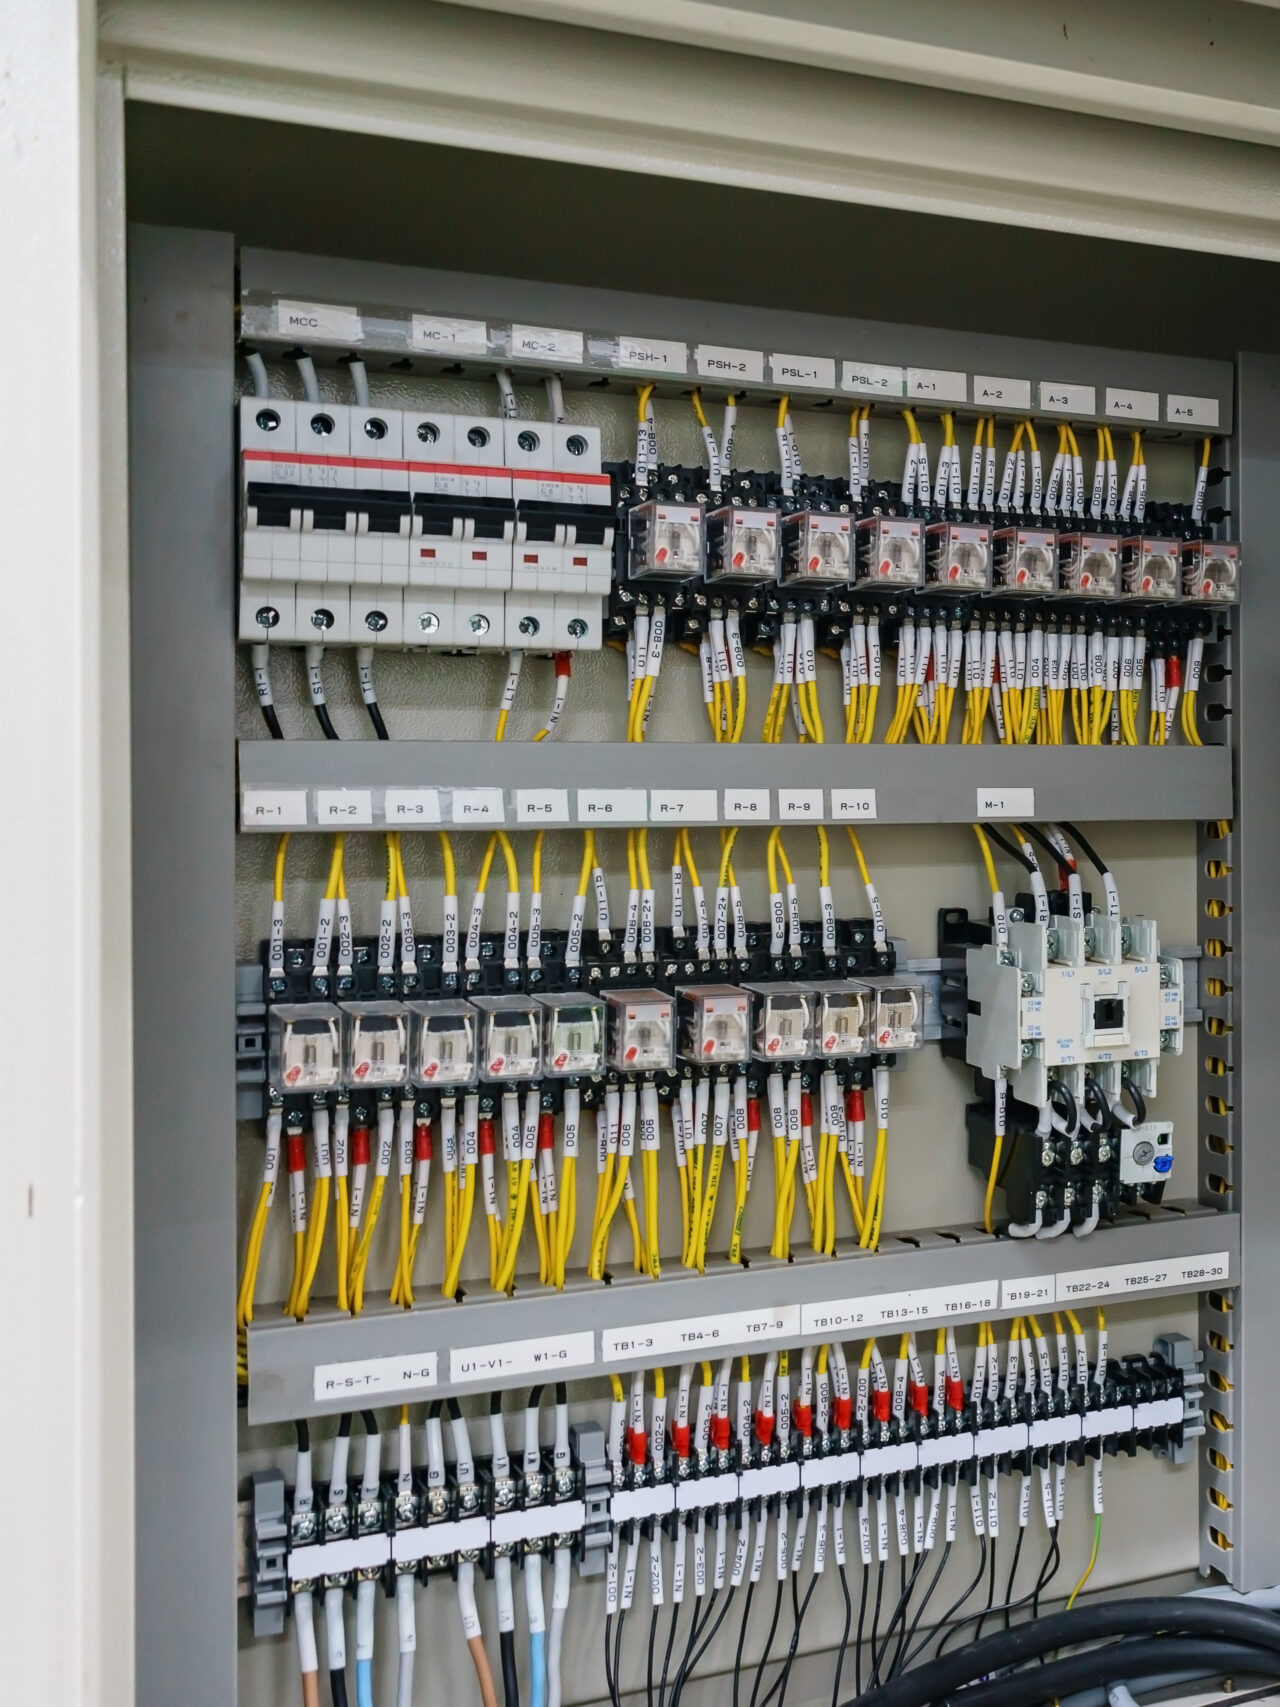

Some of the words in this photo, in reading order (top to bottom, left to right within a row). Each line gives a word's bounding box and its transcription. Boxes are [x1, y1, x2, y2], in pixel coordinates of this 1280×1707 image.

[289, 316, 318, 327] MCC
[423, 330, 456, 342] MC-1
[522, 340, 556, 351] MC-2
[630, 352, 667, 362] PSH-1
[708, 360, 746, 372] PSH-2
[782, 368, 817, 378] PSL-1
[852, 376, 888, 386] PSL-2
[917, 382, 936, 390] A-1
[982, 390, 1002, 398] A-2
[1049, 396, 1068, 404] A-3
[1114, 402, 1132, 410] A-4
[1175, 408, 1194, 416] A-5
[647, 418, 657, 455] 008-4
[638, 430, 648, 474] 011-13
[789, 432, 801, 467] 010-1
[908, 460, 917, 494] 011-7
[919, 457, 928, 492] 011-5
[938, 462, 950, 496] 011-3
[952, 462, 960, 494] 011-1
[652, 620, 662, 658] 008-3
[718, 650, 728, 672] 011
[256, 666, 269, 697] R1-1
[310, 665, 322, 695] S1-1
[361, 666, 372, 694] T1-1
[256, 806, 282, 816] R-1
[330, 806, 357, 815] R-2
[398, 804, 424, 814] R-3
[464, 804, 489, 814] R-4
[528, 804, 552, 812] R-5
[588, 804, 613, 813] R-6
[661, 804, 684, 812] R-7
[734, 802, 758, 812] R-8
[788, 802, 811, 812] R-9
[840, 802, 870, 811] R-10
[1039, 893, 1048, 922] R1-1
[1072, 892, 1082, 919] S1-1
[1109, 890, 1118, 916] T1-1
[403, 912, 414, 952] 003-3
[469, 908, 482, 948] 004-3
[508, 911, 518, 950] 004-2
[775, 902, 784, 939] 008-3
[997, 914, 1008, 934] 010
[272, 919, 282, 960] 001-3
[317, 918, 330, 958] 001-2
[340, 915, 350, 956] 002-3
[381, 919, 392, 958] 002-2
[446, 913, 456, 952] 003-2
[570, 914, 583, 953] 005-2
[714, 1114, 723, 1136] 007
[737, 1108, 745, 1130] 008
[774, 1106, 782, 1128] 008
[466, 1131, 476, 1154] 004
[512, 1125, 520, 1148] 004
[526, 1125, 536, 1149] 005
[566, 1124, 576, 1147] 005
[610, 1123, 618, 1144] 011
[622, 1124, 632, 1146] 006
[1066, 1281, 1110, 1294] TB22-24
[1125, 1274, 1167, 1286] TB25-27
[1182, 1267, 1222, 1280] TB28-30
[1007, 1288, 1048, 1301] B19-21
[814, 1314, 864, 1328] TB10-12
[880, 1306, 928, 1319] TB13-15
[945, 1299, 990, 1312] TB16-18
[614, 1338, 653, 1351] TB1-3
[680, 1329, 720, 1342] TB4-6
[746, 1320, 784, 1333] TB7-9
[534, 1350, 568, 1362] W1-G
[403, 1368, 430, 1380] N-G
[974, 1365, 984, 1398] 011-1
[743, 1400, 751, 1436] 004-2
[656, 1415, 664, 1451] 002-2
